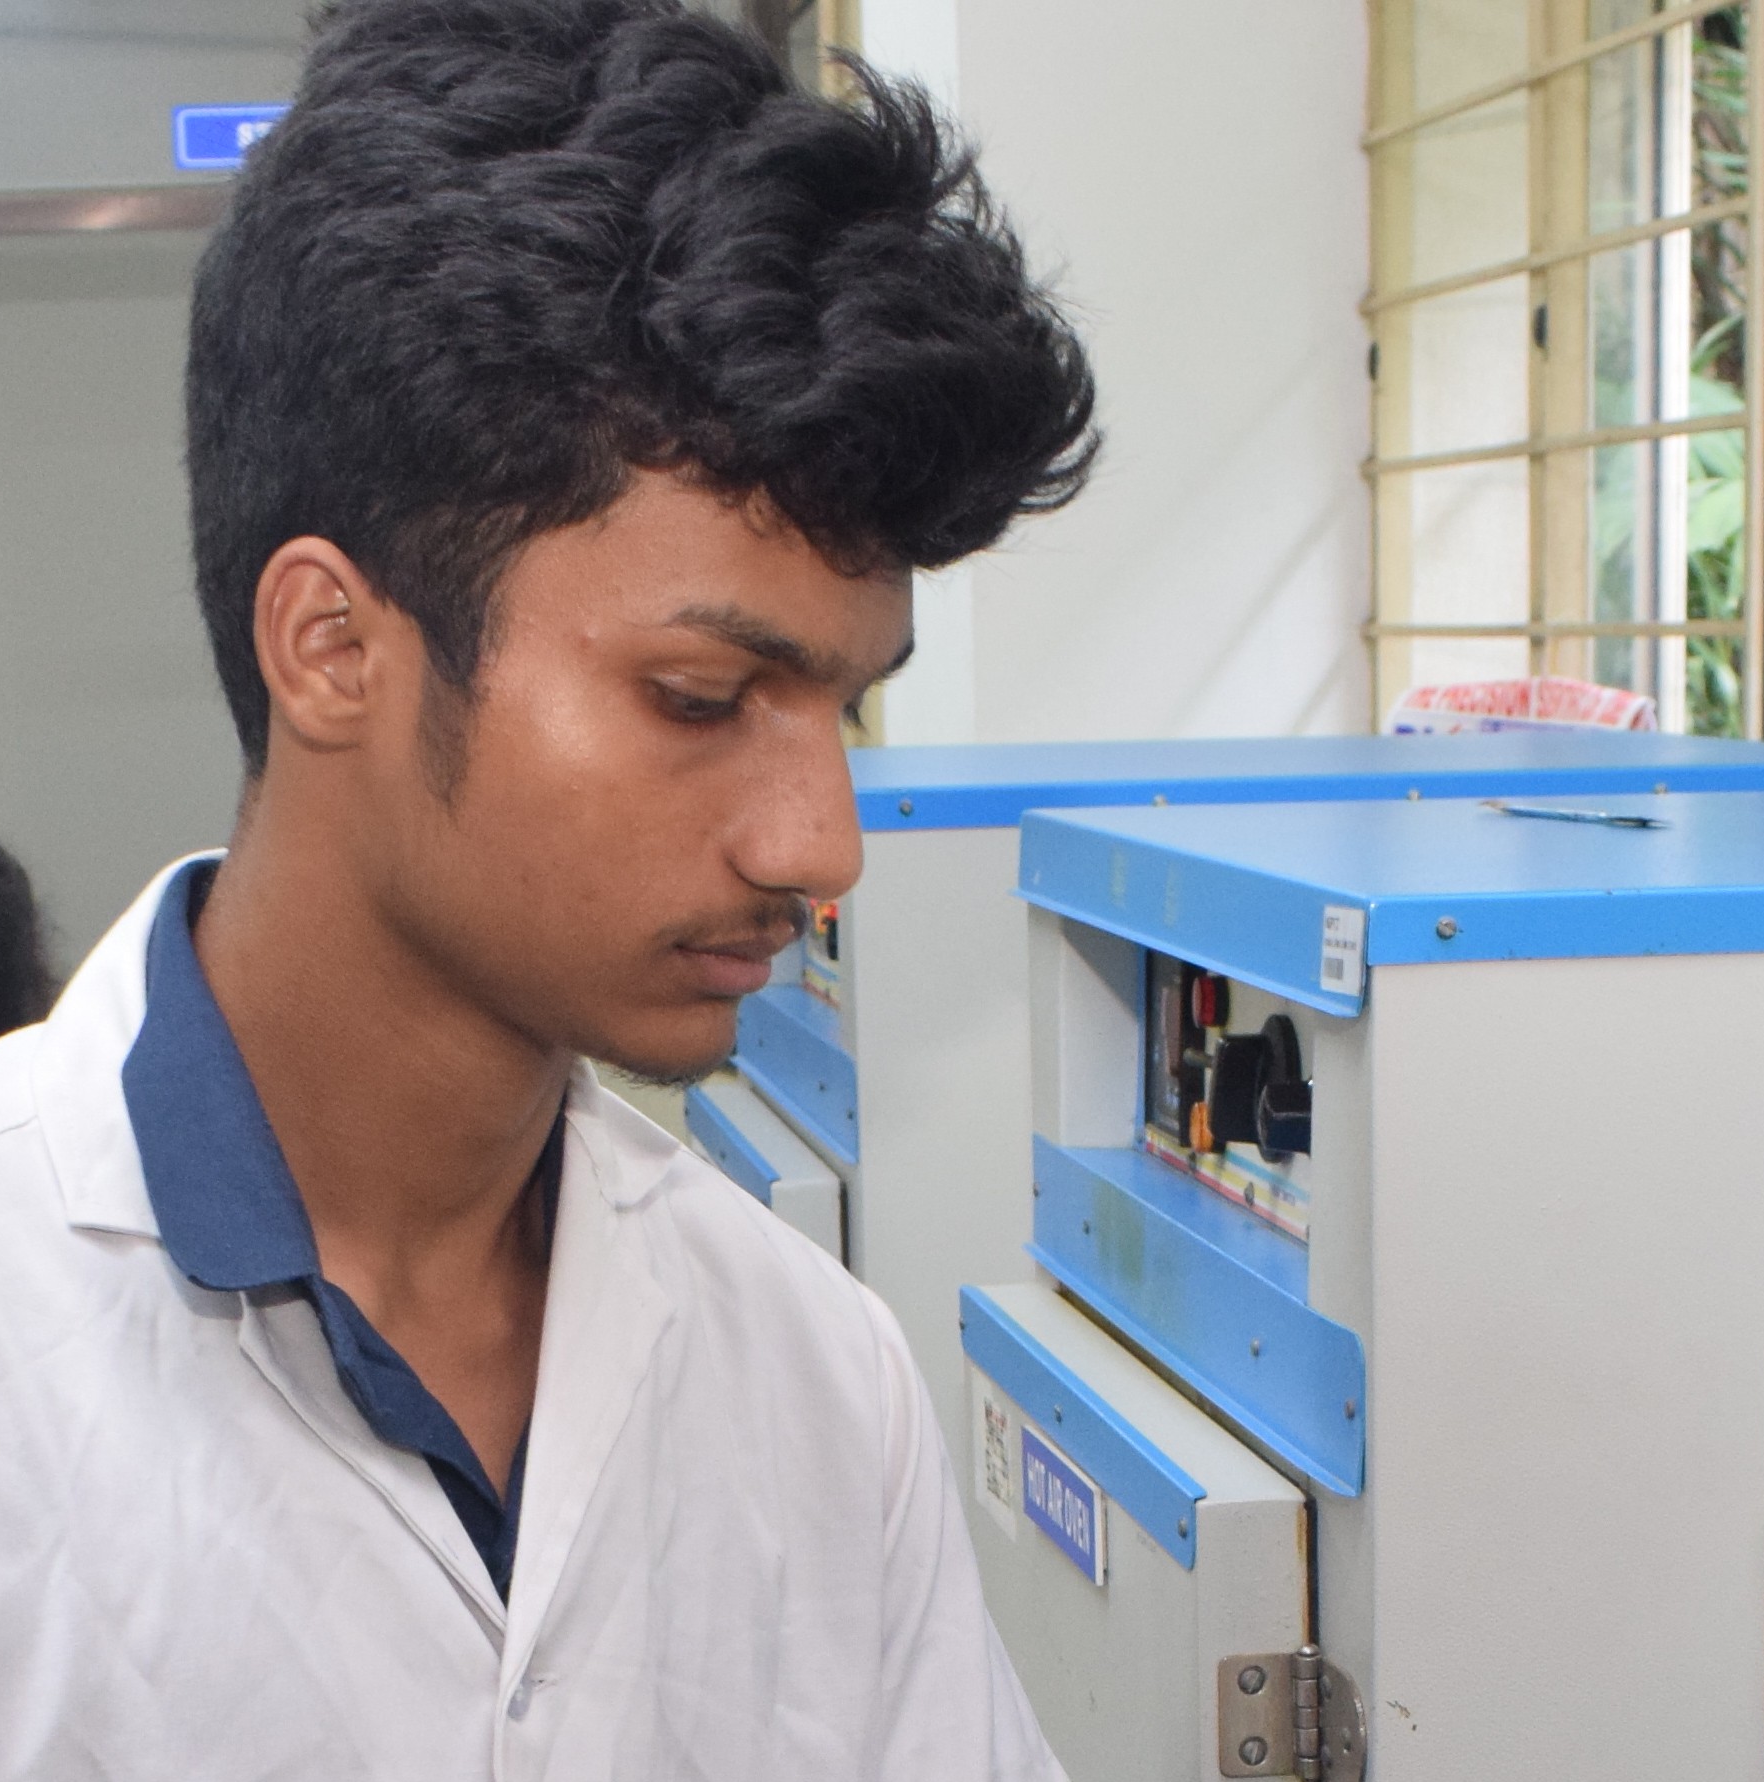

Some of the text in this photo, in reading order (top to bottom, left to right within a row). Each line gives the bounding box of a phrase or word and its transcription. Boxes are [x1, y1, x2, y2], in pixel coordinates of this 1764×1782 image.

[1027, 1452, 1046, 1512] HOT
[1047, 1470, 1063, 1530] AIR
[1064, 1486, 1091, 1556] OVEN
